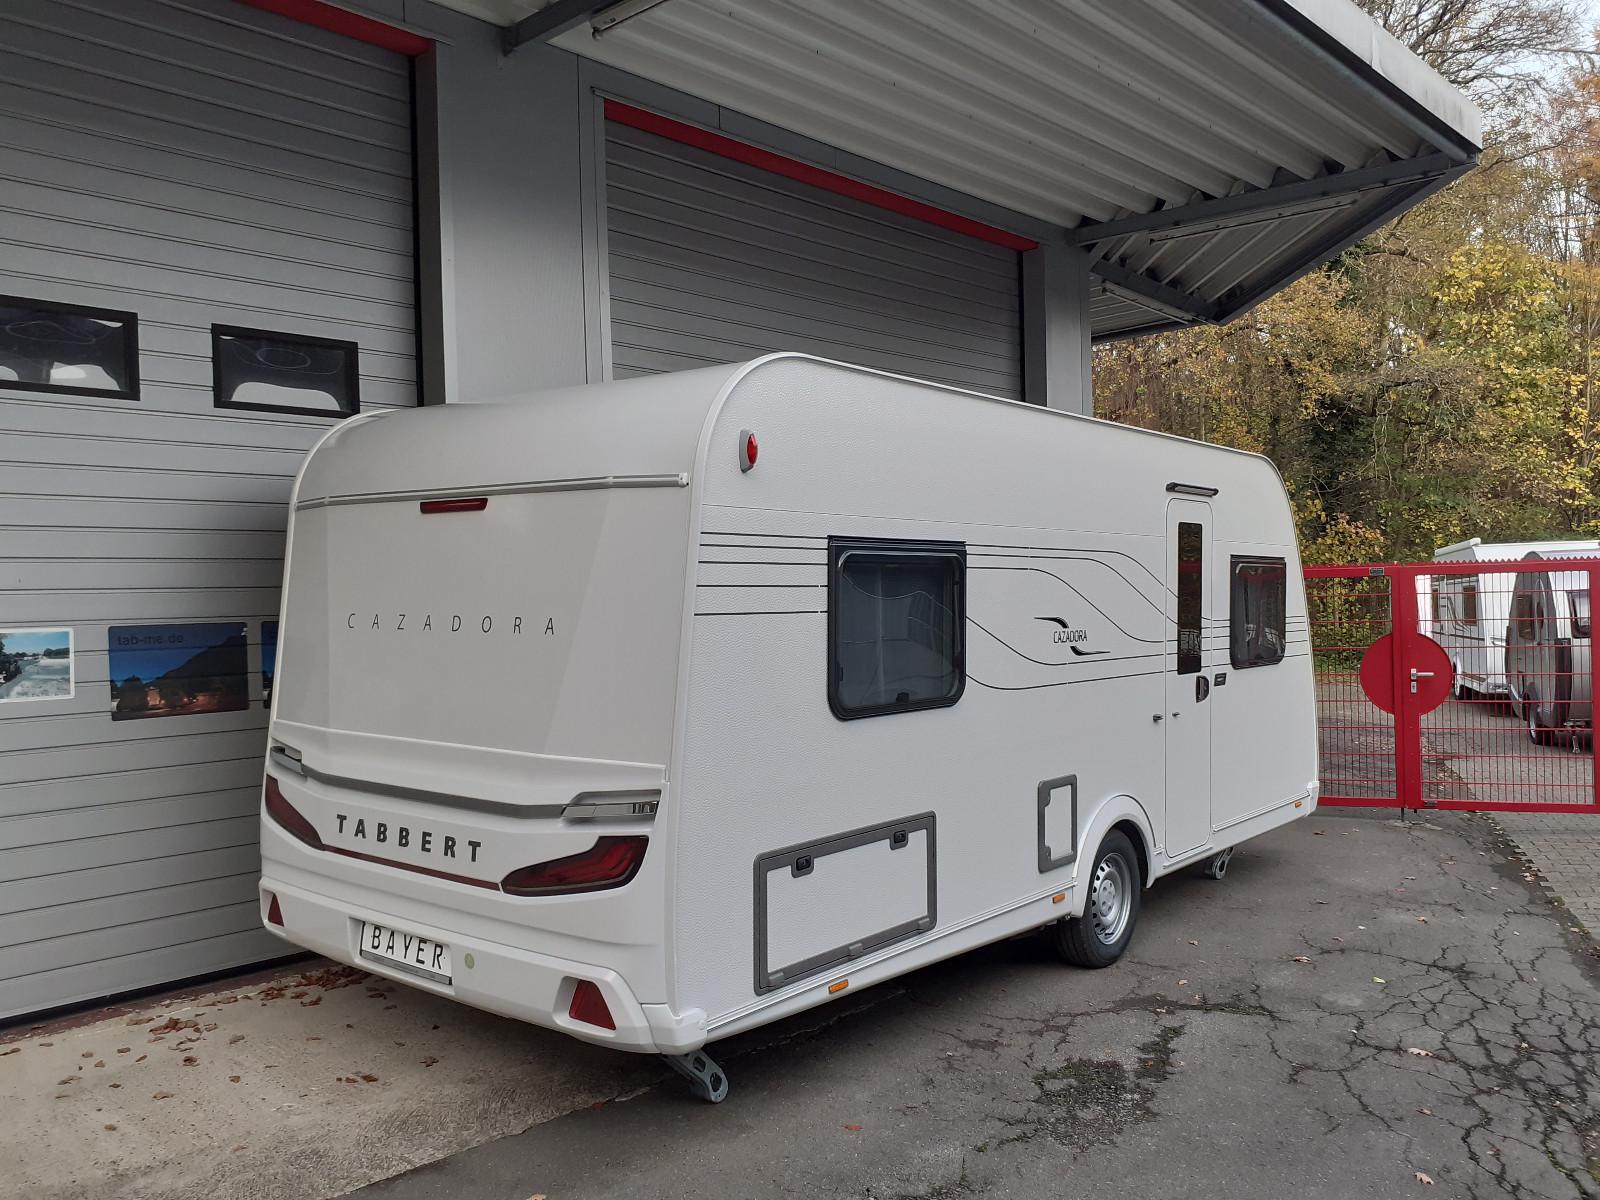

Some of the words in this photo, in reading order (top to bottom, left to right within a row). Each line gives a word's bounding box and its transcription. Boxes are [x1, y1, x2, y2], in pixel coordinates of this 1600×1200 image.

[347, 613, 554, 635] CAZADORA
[117, 633, 185, 646] tab-mede
[1053, 629, 1087, 643] CAZADORA
[336, 814, 481, 862] TABBERT
[371, 926, 444, 970] BAYER
